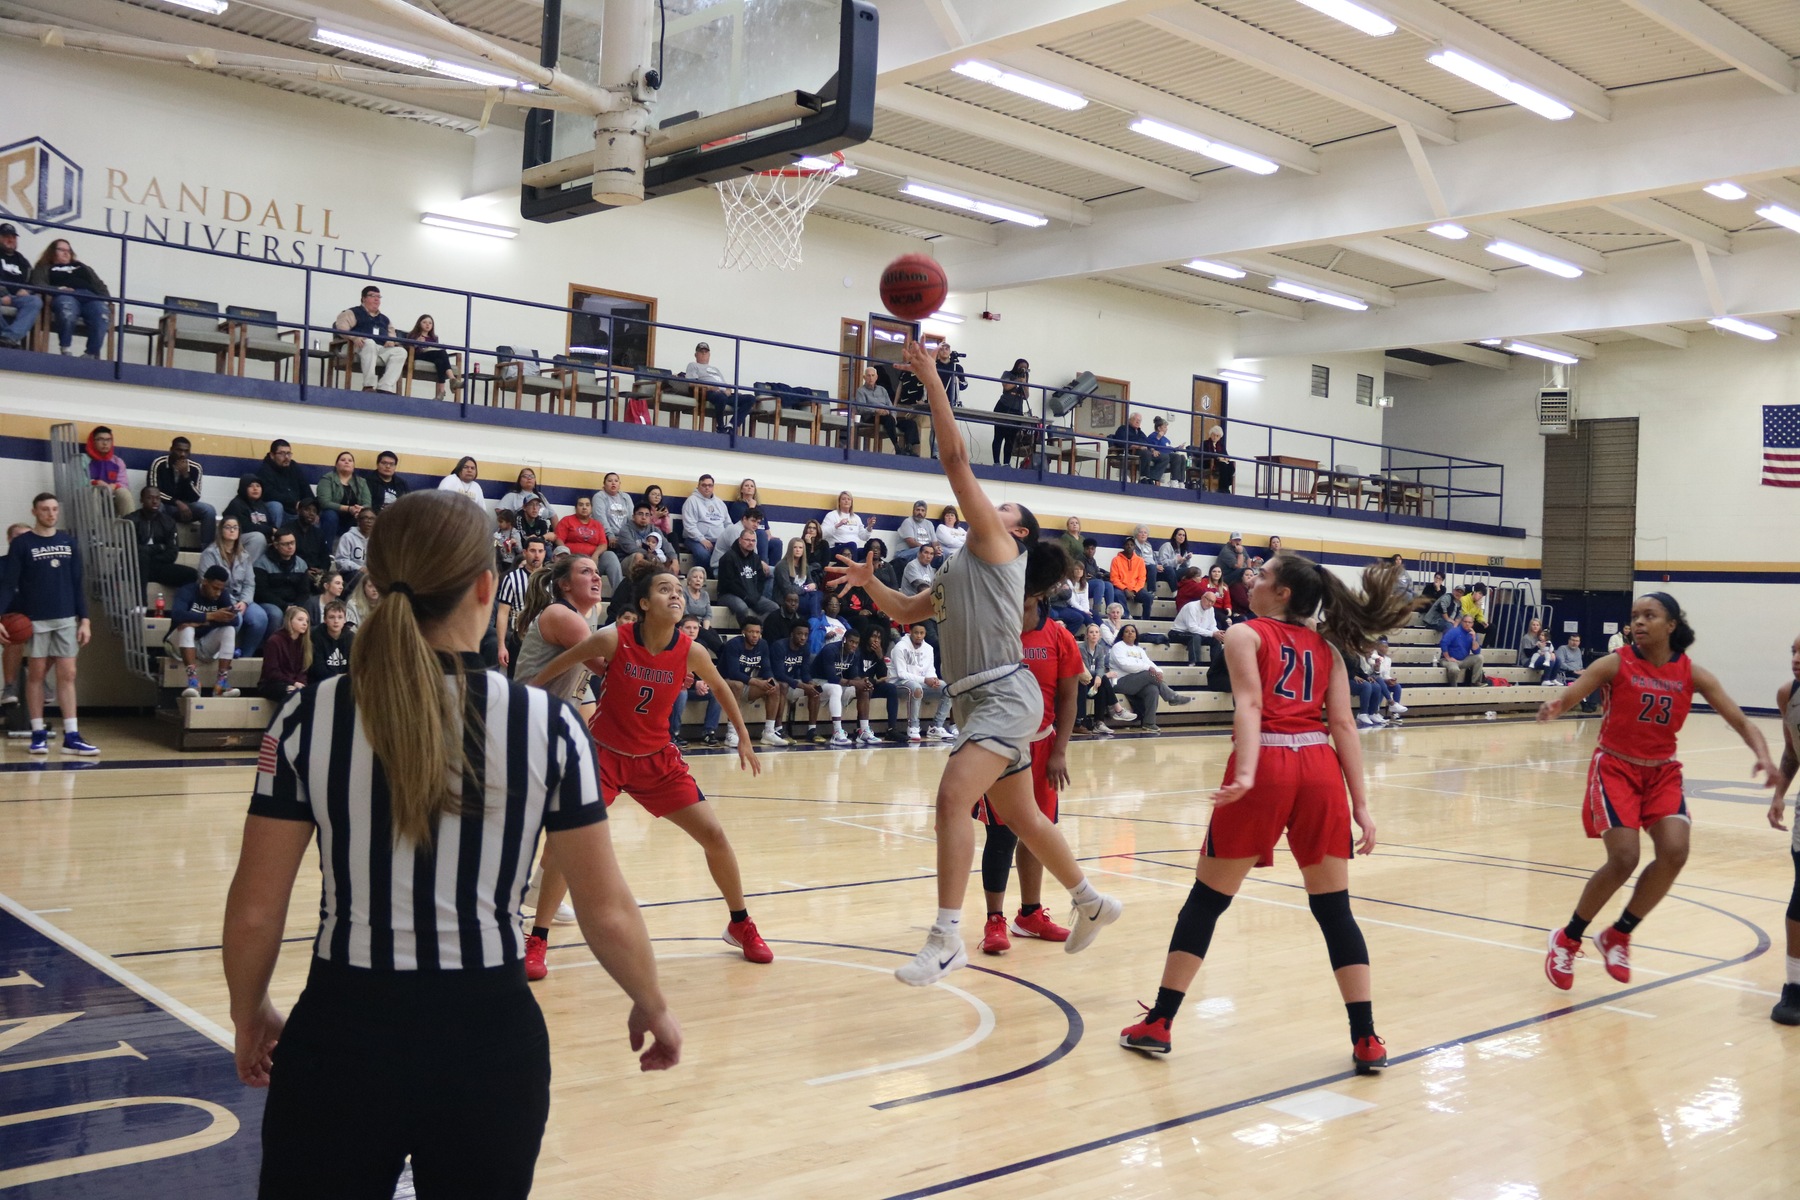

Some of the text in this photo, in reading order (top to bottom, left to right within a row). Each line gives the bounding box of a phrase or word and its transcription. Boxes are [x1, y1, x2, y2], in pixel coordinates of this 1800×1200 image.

[104, 166, 341, 240] RANDALL
[103, 206, 383, 277] UNIVERSITY
[31, 545, 72, 555] SAINTS
[1489, 556, 1505, 566] EXIT
[624, 661, 674, 685] PATRIOTS
[1273, 642, 1315, 703] 21
[1631, 674, 1683, 693] PATRIOTS
[633, 685, 655, 714] 2
[1637, 692, 1673, 726] 23
